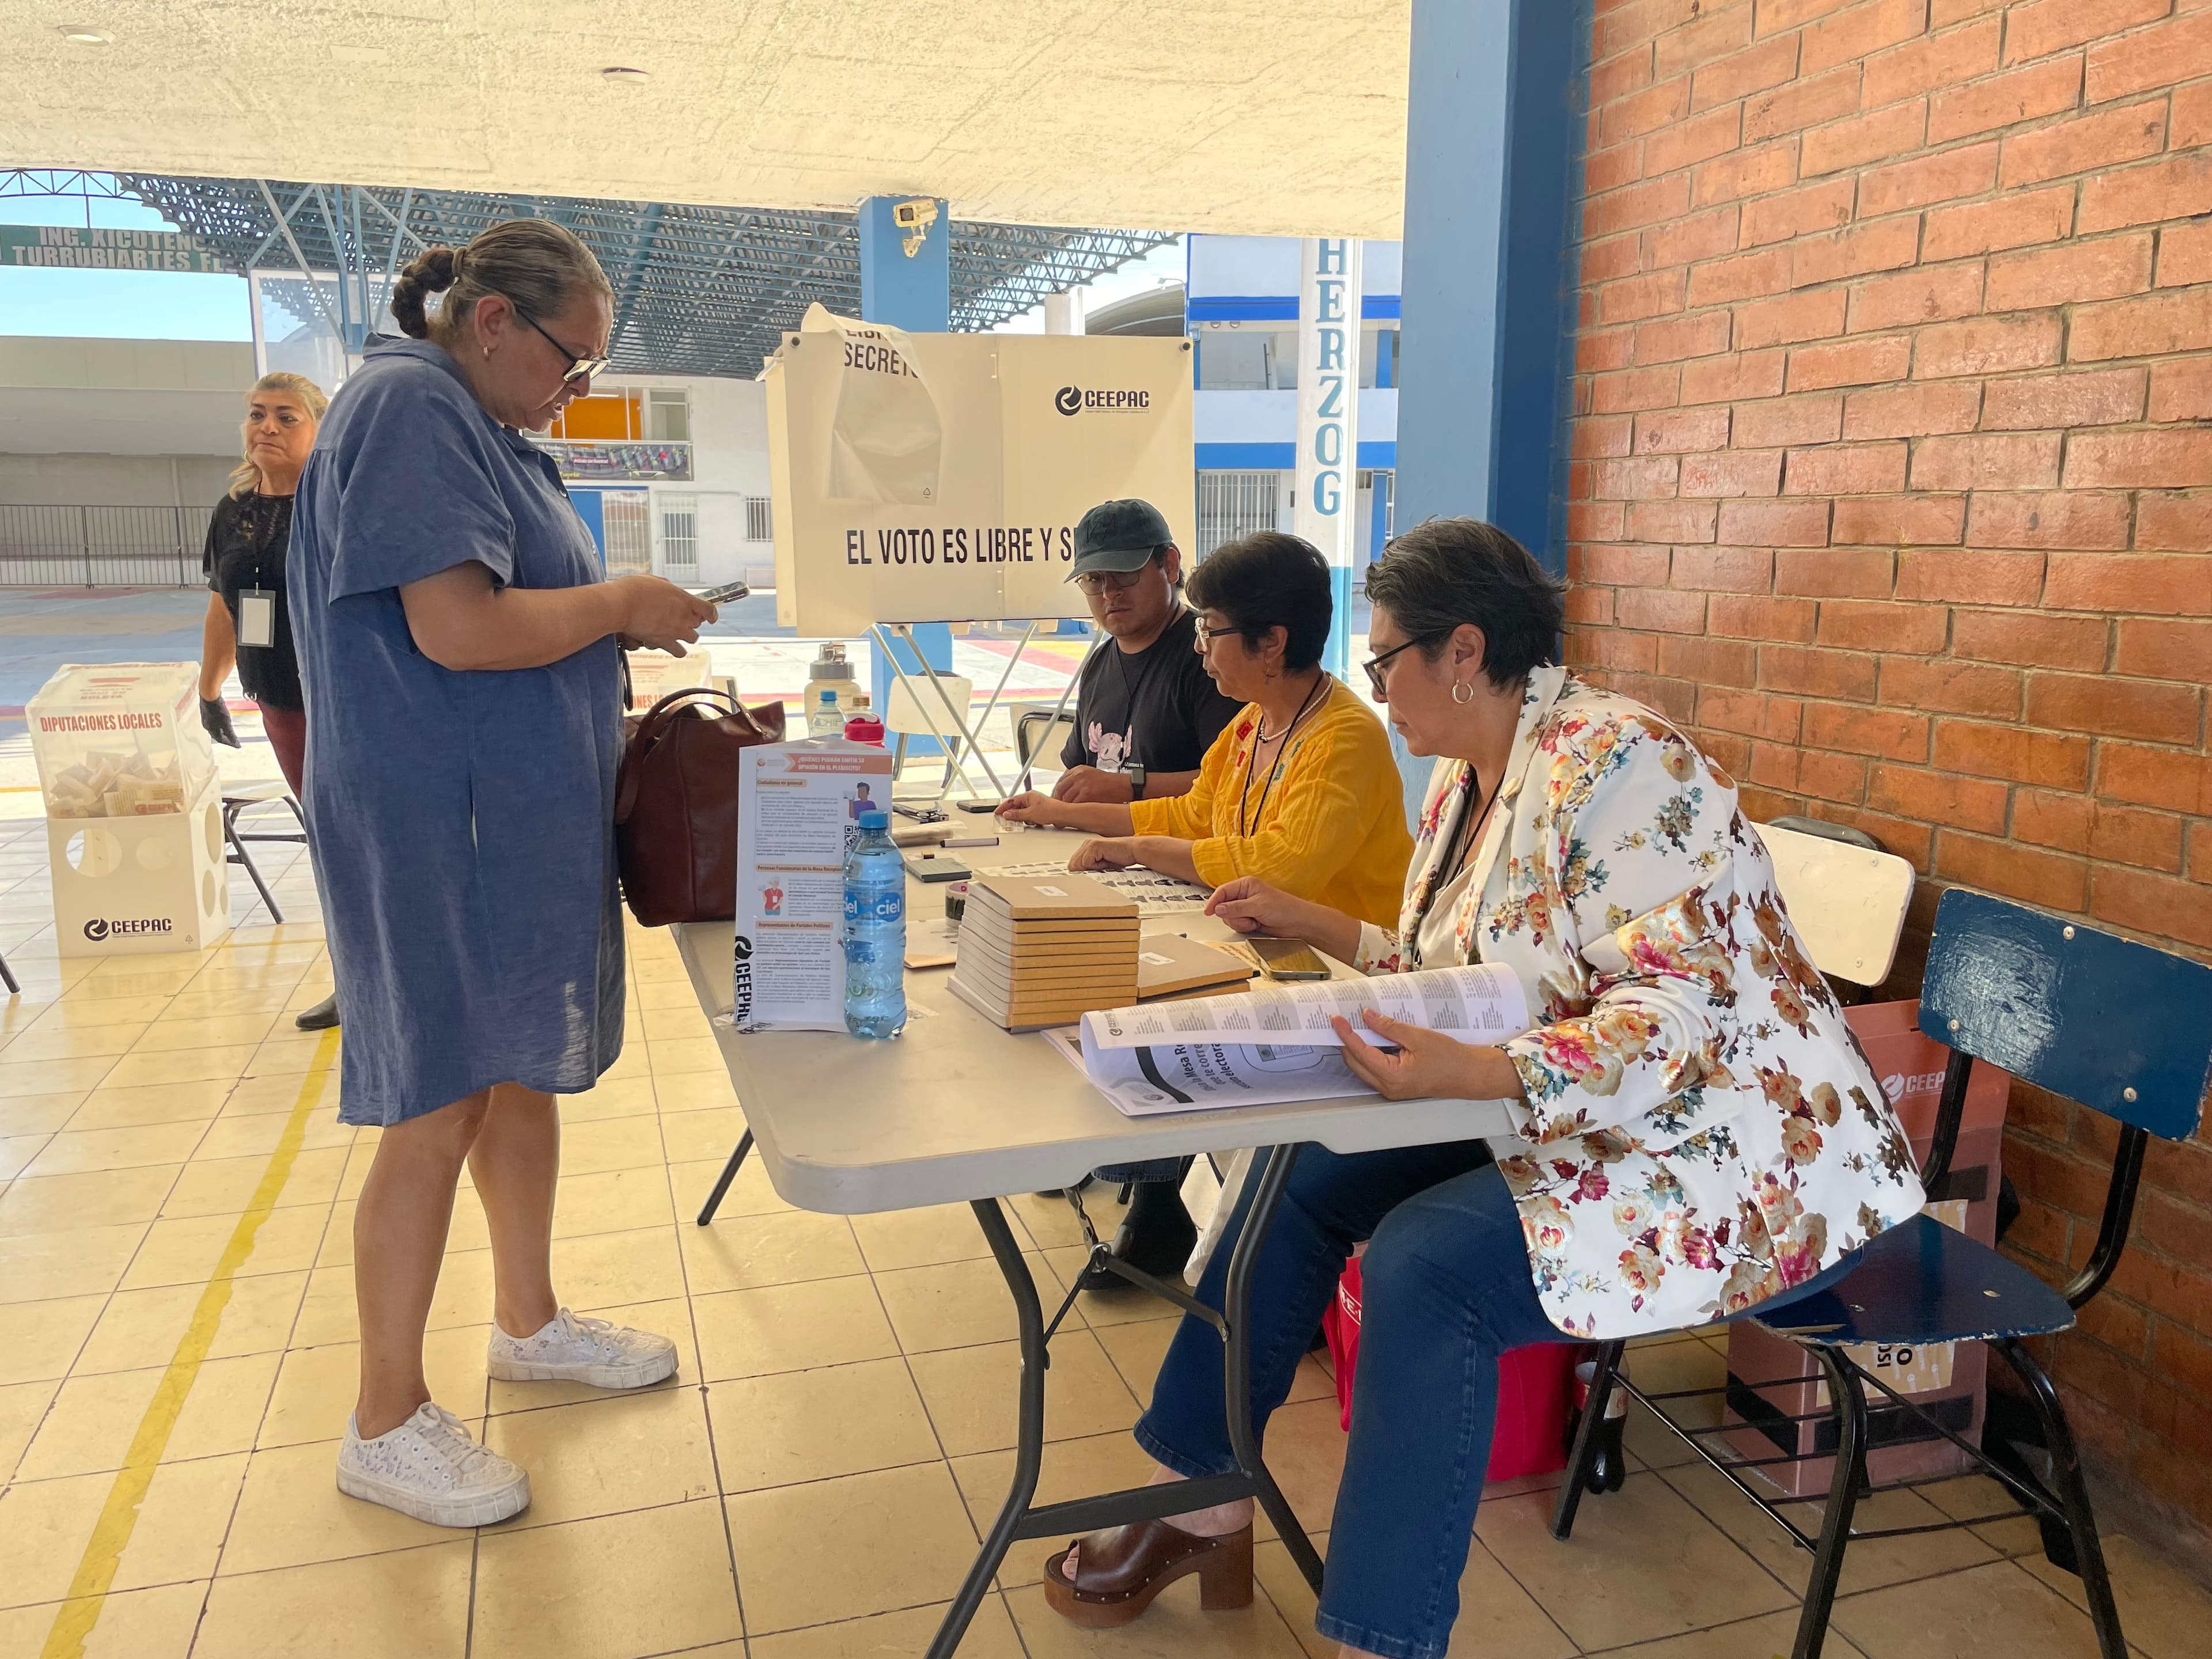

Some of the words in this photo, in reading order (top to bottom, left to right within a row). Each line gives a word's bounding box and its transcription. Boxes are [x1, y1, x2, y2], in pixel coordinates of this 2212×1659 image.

[39, 227, 86, 247] ING.
[12, 246, 192, 271] TURRUBIARTES
[844, 342, 918, 378] SECRE
[1313, 238, 1349, 516] HERZOG
[1085, 390, 1149, 407] CEEPAC
[847, 529, 872, 564] EL
[878, 529, 934, 564] VOTO
[943, 529, 967, 563] ES
[976, 528, 1033, 562] LIBRE
[1040, 527, 1052, 560] Y
[1060, 527, 1077, 560] S
[40, 714, 116, 732] DIPUTACIONES
[118, 713, 162, 730] LOCALES
[877, 899, 900, 915] ciel
[112, 918, 172, 933] CEEPAC
[1181, 1056, 1198, 1078] Mesa
[1906, 1071, 1945, 1093] CEEP
